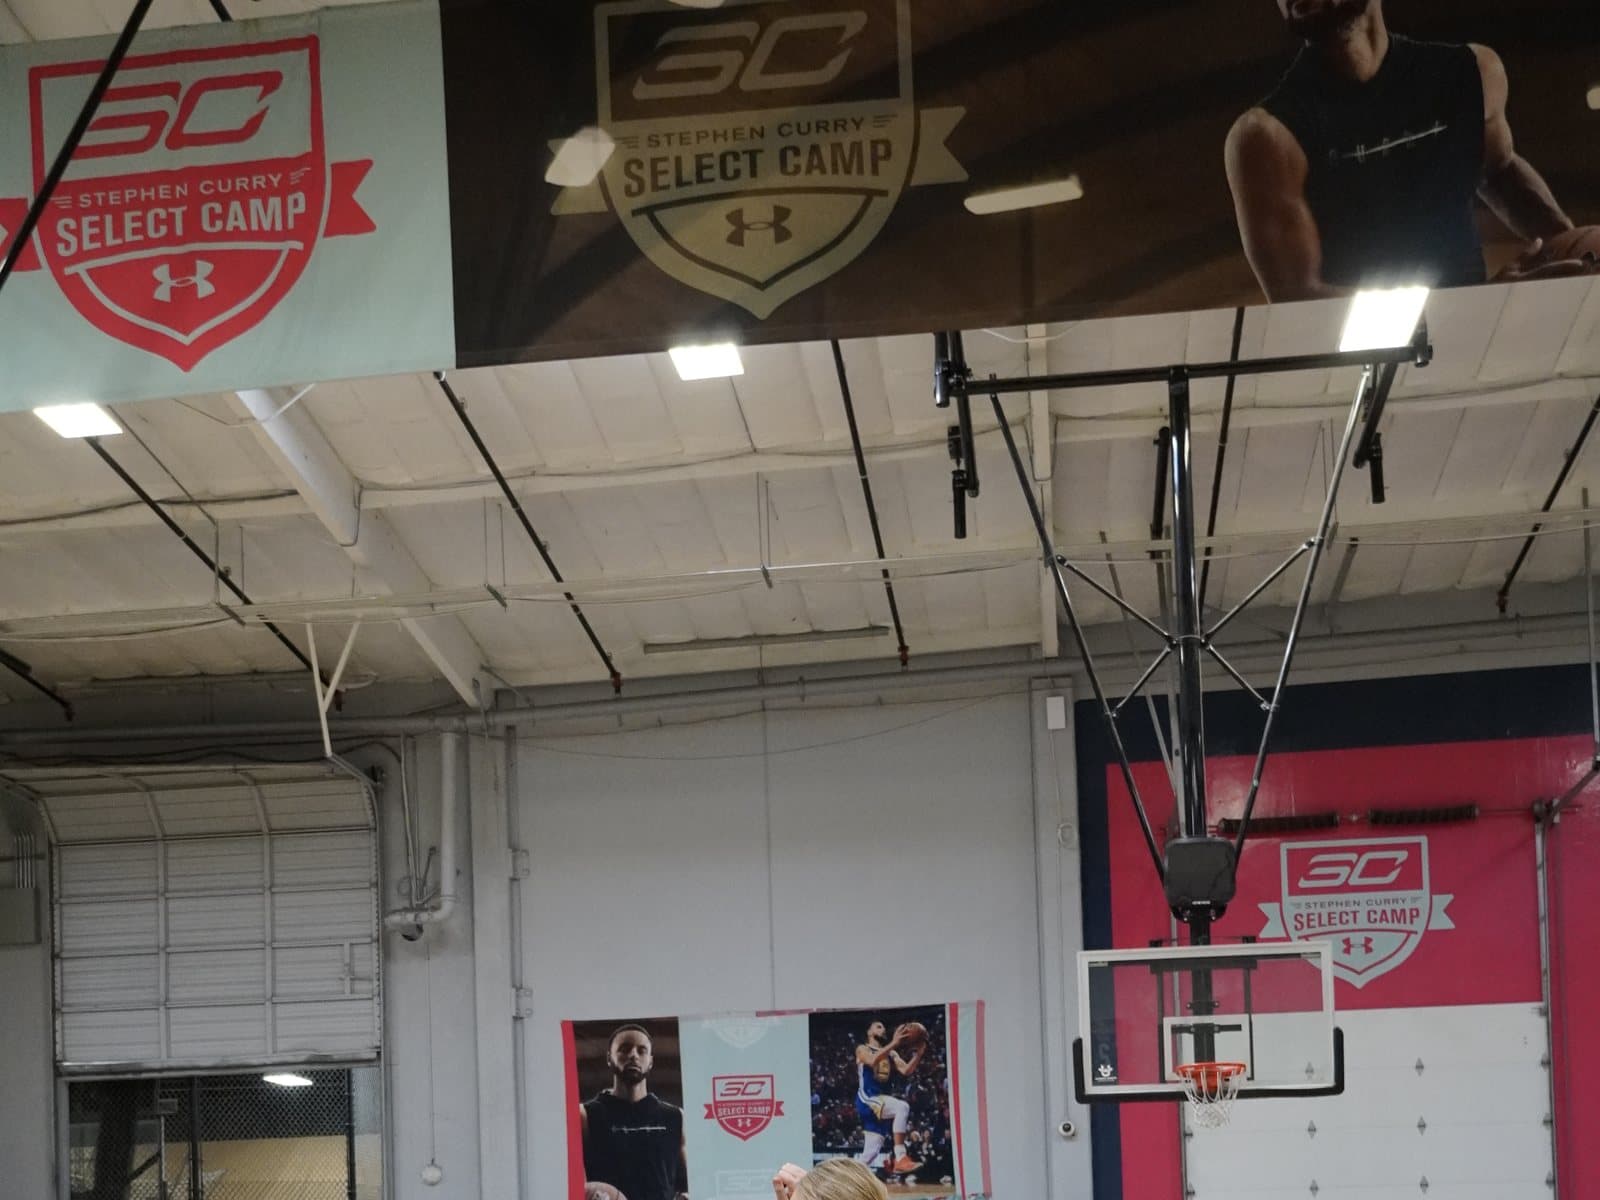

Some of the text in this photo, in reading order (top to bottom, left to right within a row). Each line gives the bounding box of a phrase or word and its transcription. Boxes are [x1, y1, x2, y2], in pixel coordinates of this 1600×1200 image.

[632, 11, 868, 100] SC
[648, 117, 864, 148] STEPHEN CURRY
[623, 139, 892, 197] SELECT CAMP
[79, 174, 282, 208] STEPHEN CURRY
[57, 192, 306, 257] SELECT CAMP
[1304, 897, 1407, 909] STEPHEN CURRY
[1294, 908, 1420, 931] SELECT CAMP
[718, 1106, 771, 1117] SELECT CAMP
